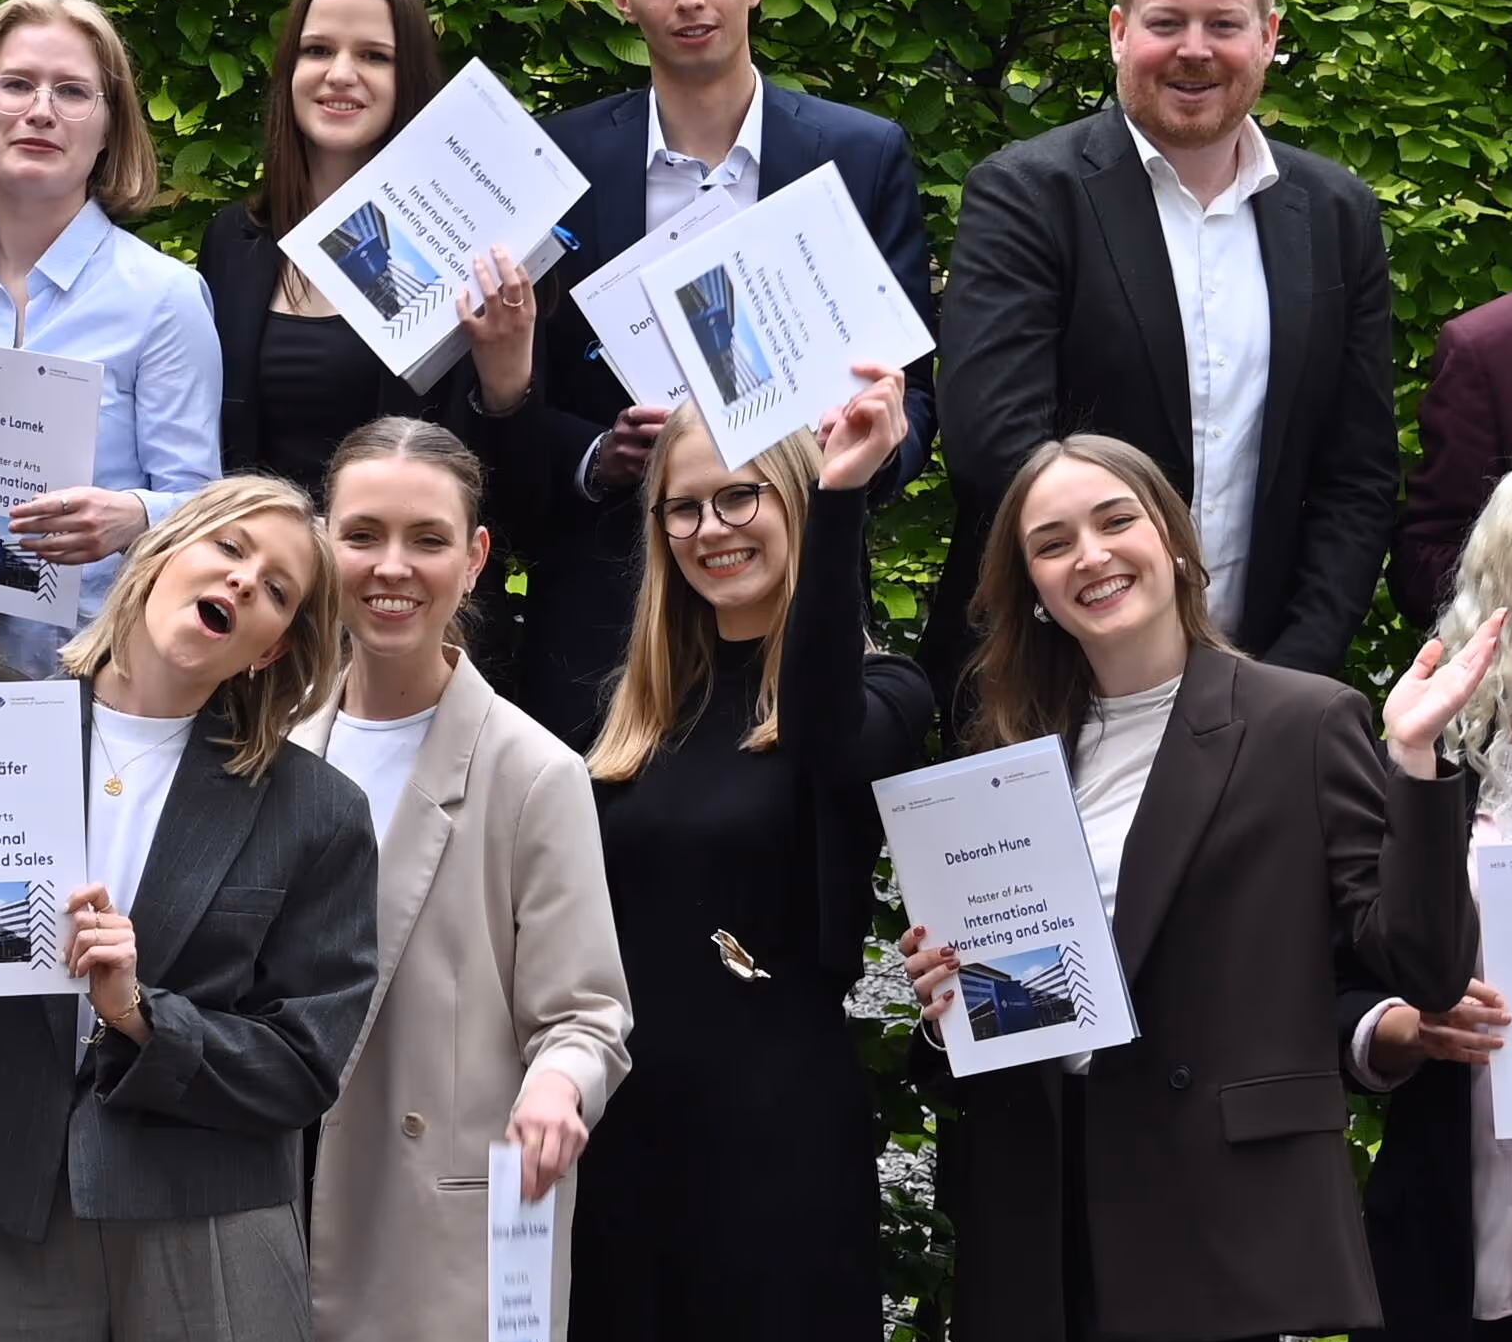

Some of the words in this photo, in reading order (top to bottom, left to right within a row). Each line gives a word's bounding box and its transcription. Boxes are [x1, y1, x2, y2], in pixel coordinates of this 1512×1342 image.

[444, 134, 472, 167] Malin
[469, 161, 517, 216] Espenhahn
[407, 184, 472, 254] International
[428, 178, 454, 206] Master
[452, 205, 465, 216] of
[459, 213, 477, 233] Arts
[379, 181, 428, 237] Marketing
[426, 234, 450, 256] and
[444, 252, 471, 282] Sales
[9, 415, 45, 434] Lamek
[12, 458, 23, 469] of
[23, 460, 41, 474] Arts
[12, 497, 27, 506] an
[14, 851, 54, 867] Sales
[944, 842, 997, 866] Deborah
[997, 837, 1031, 854] Hune
[967, 891, 1000, 907] Master
[1001, 885, 1012, 898] of
[1013, 884, 1034, 896] Arts
[963, 898, 1048, 930] International
[947, 930, 1014, 957] Marketing
[1015, 920, 1040, 939] and
[1041, 916, 1075, 933] Sales
